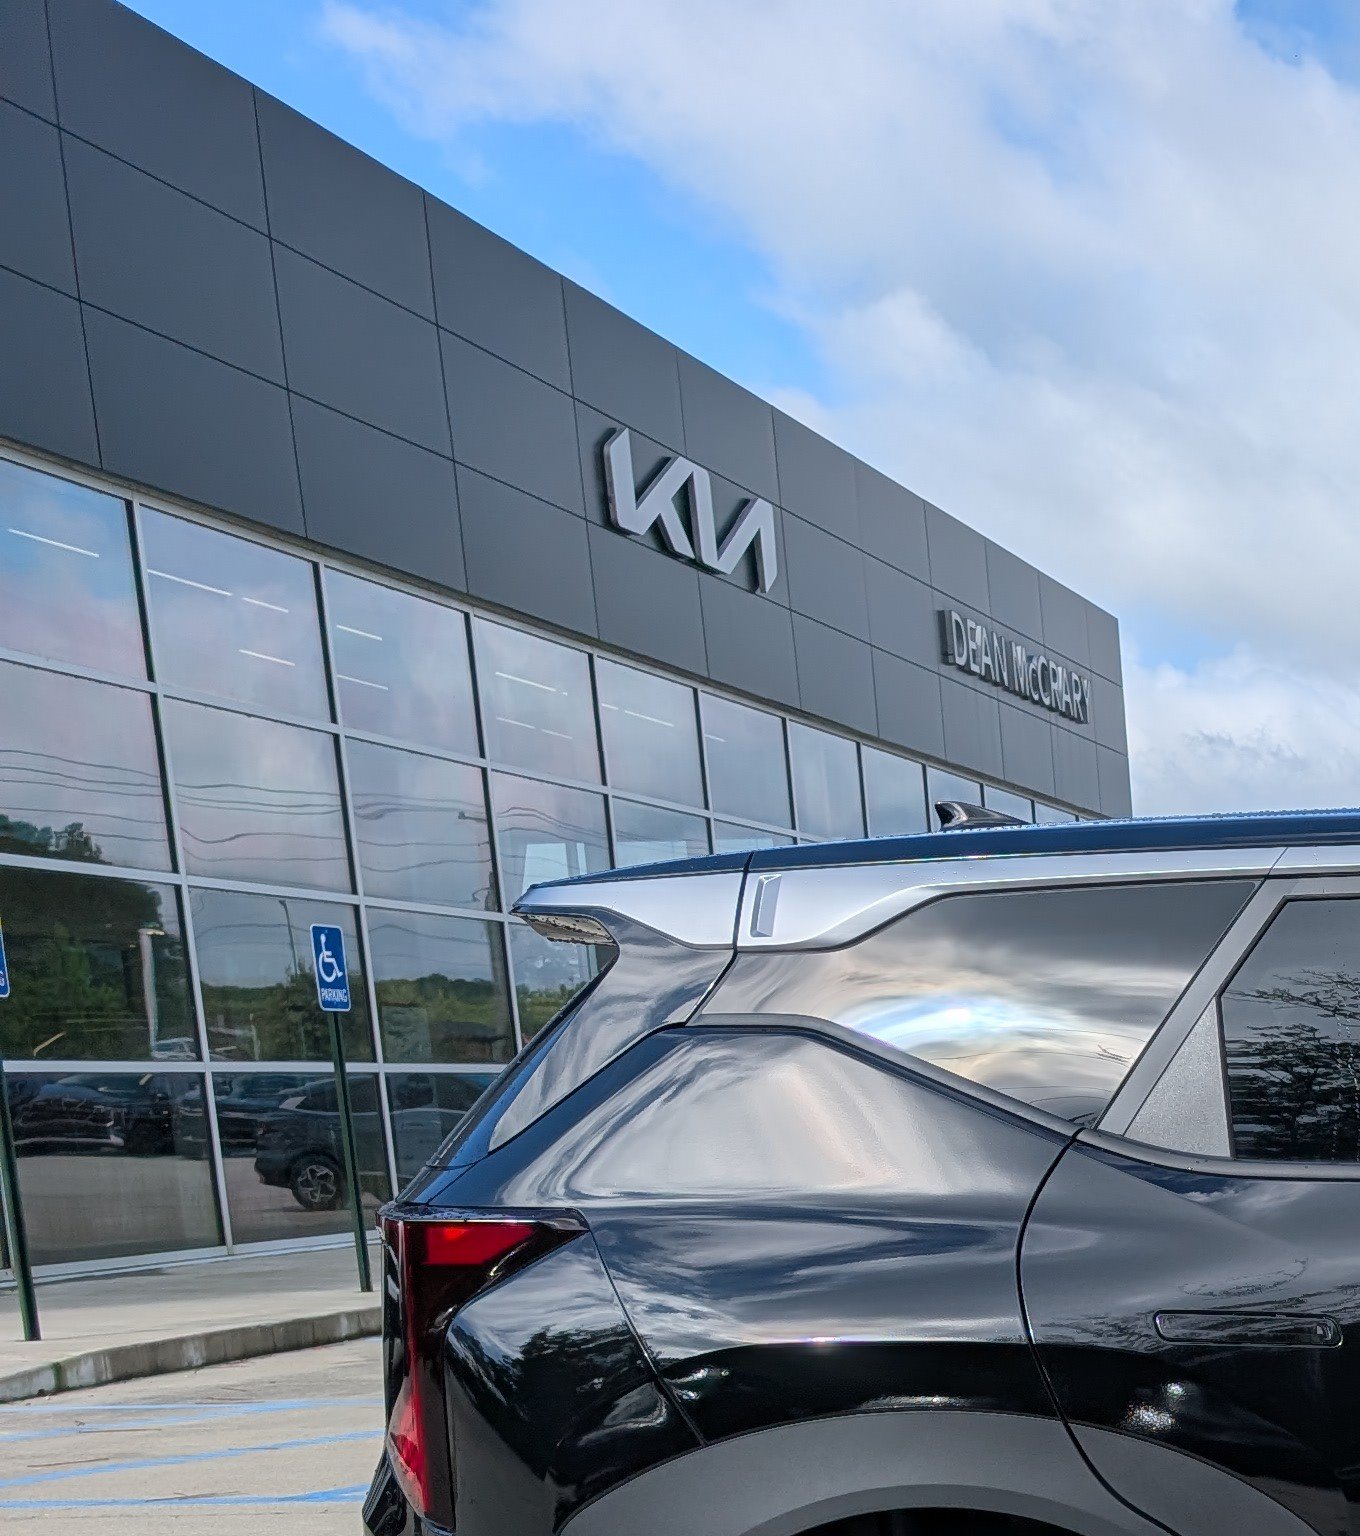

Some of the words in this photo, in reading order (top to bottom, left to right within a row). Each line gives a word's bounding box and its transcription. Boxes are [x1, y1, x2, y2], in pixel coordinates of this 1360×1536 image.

[945, 609, 1010, 688] DEAN
[1011, 641, 1092, 724] McCRARY
[320, 987, 348, 1003] PARKING
